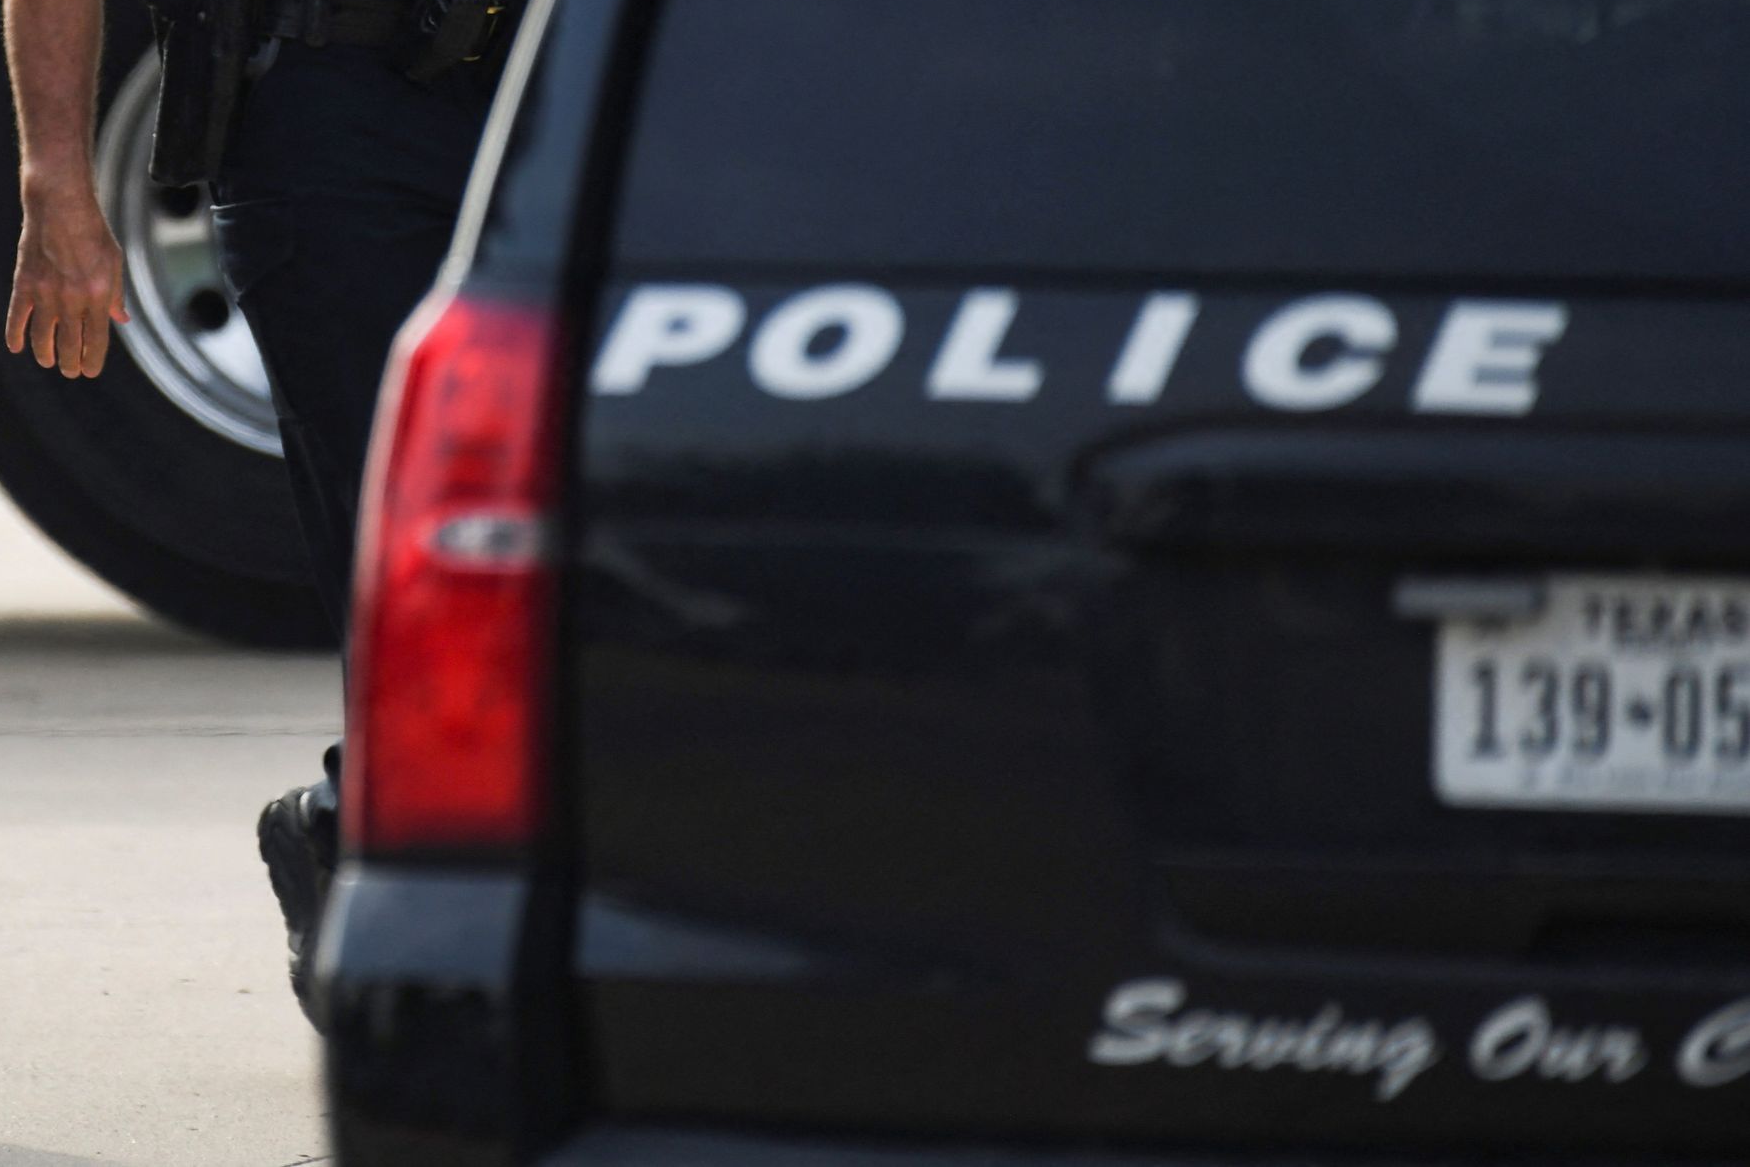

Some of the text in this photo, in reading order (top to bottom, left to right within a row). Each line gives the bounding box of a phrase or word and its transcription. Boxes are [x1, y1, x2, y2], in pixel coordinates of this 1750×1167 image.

[591, 280, 1572, 417] POLICE
[1087, 976, 1440, 1102] Serving
[1469, 994, 1647, 1082] Our
